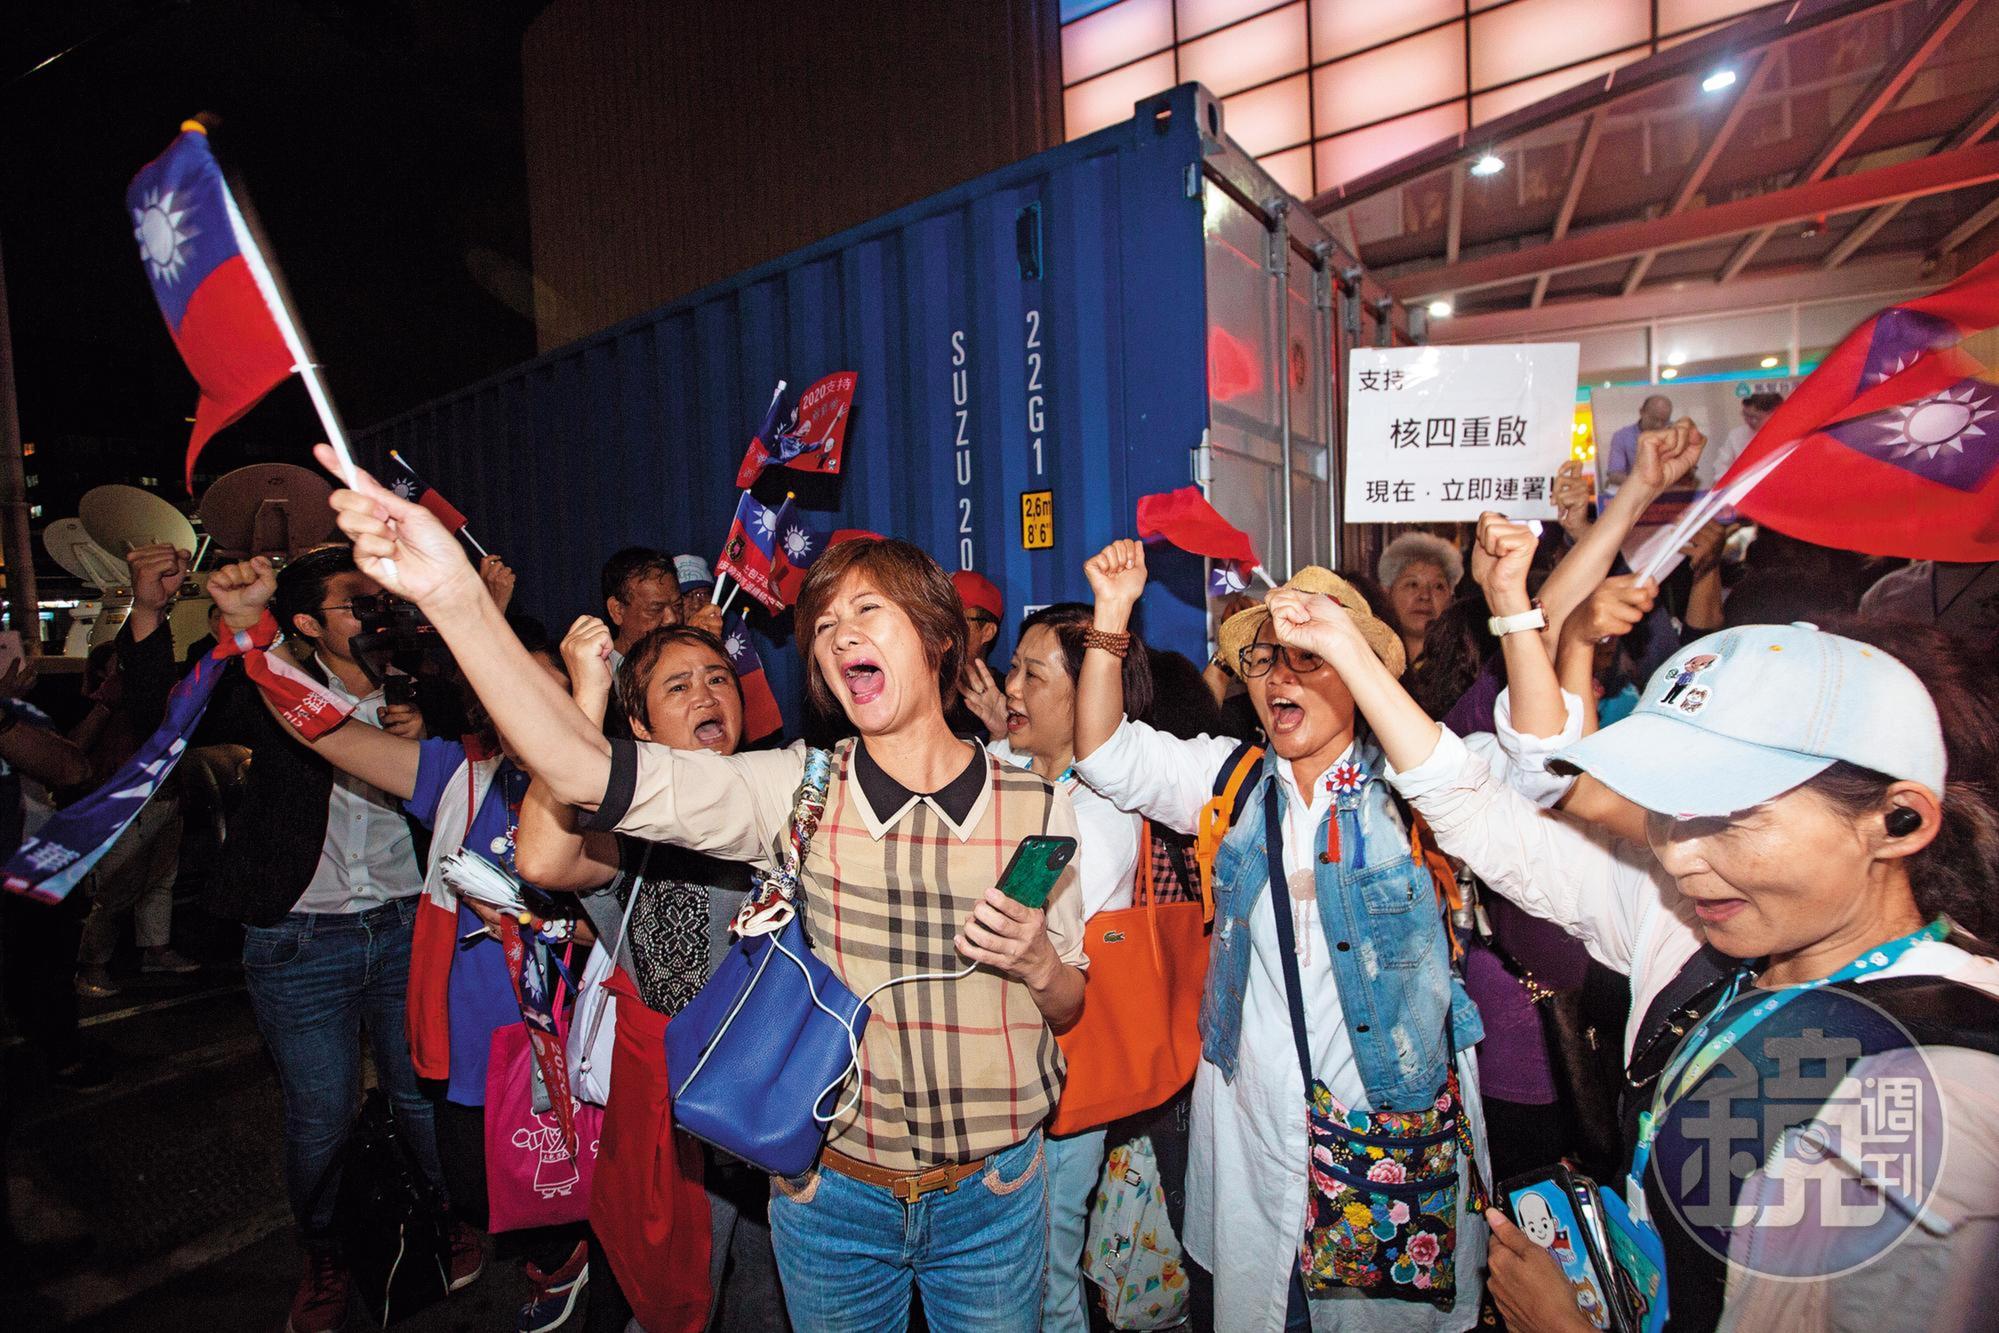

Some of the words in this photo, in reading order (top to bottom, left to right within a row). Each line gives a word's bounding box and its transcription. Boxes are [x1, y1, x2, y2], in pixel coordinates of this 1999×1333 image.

[802, 378, 851, 410] 2020支持
[1025, 310, 1045, 476] 22G1
[1358, 369, 1404, 391] 支持
[951, 330, 971, 486] SUZU
[1390, 415, 1528, 449] 核四重啟
